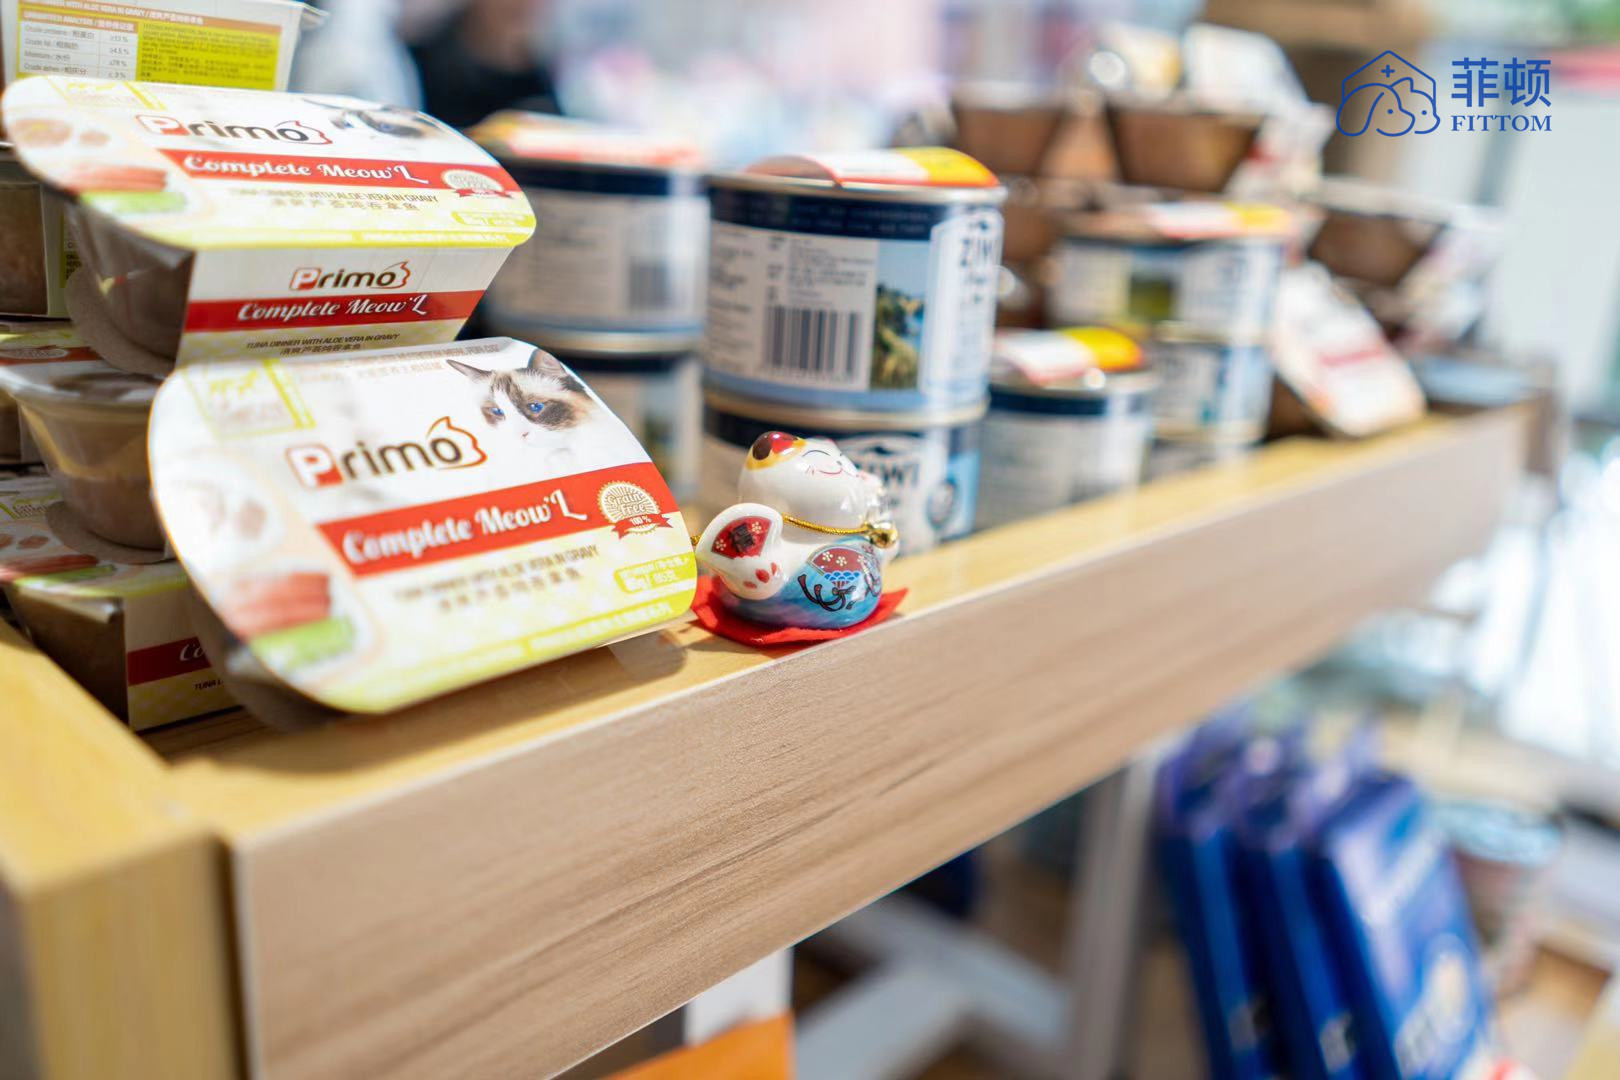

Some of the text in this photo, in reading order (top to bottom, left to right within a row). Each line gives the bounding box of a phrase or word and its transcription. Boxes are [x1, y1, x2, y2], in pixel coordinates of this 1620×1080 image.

[137, 113, 311, 144] Primo
[184, 154, 311, 178] Complete
[291, 268, 397, 291] Primo
[237, 302, 341, 322] Complete
[289, 433, 466, 487] Primo
[607, 493, 641, 508] Grain
[620, 503, 646, 514] Free
[342, 516, 473, 564] Complete
